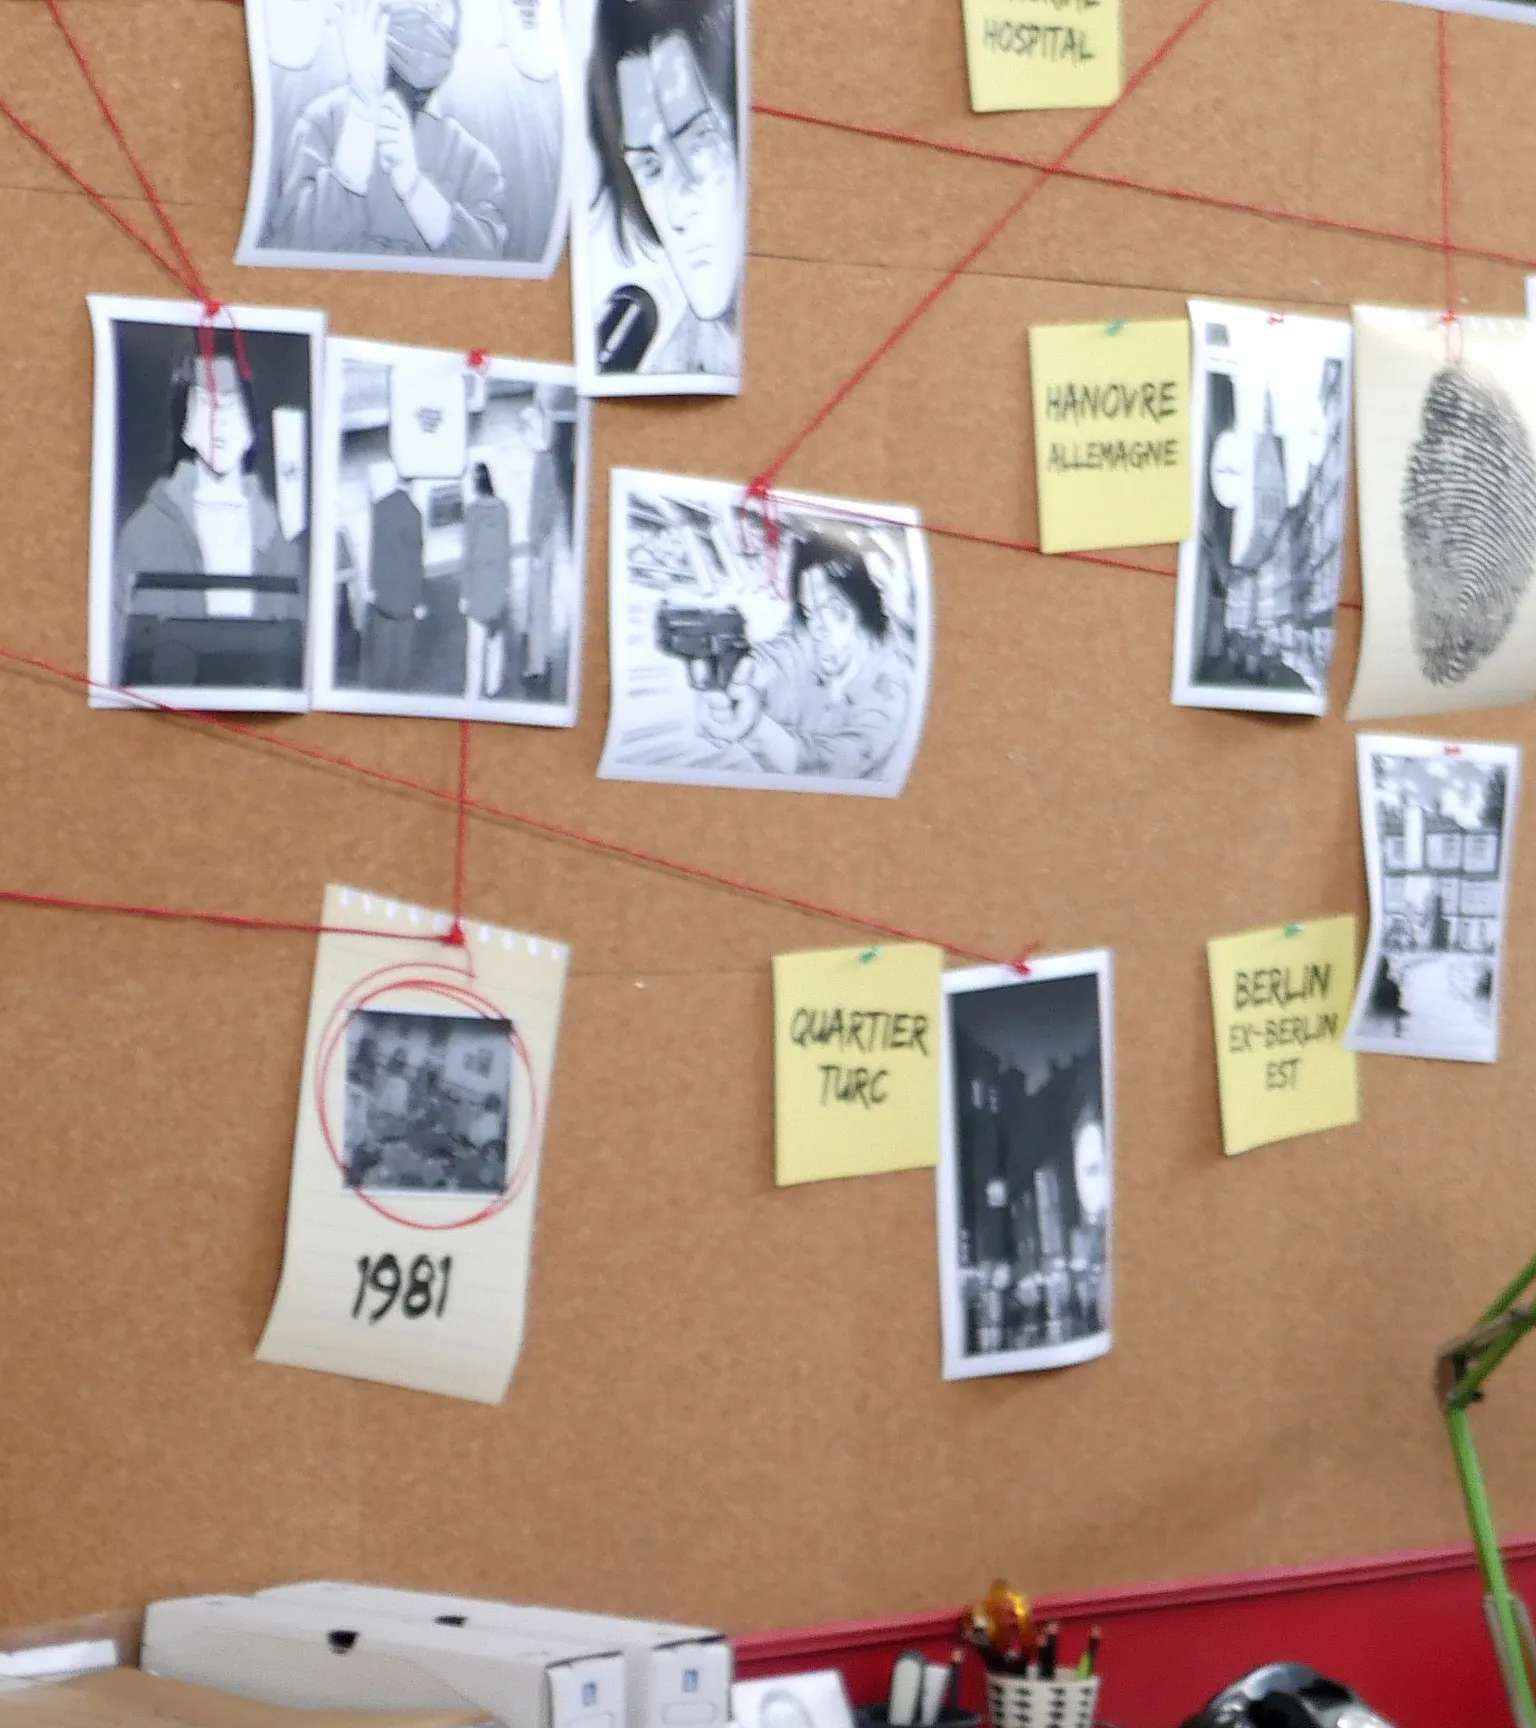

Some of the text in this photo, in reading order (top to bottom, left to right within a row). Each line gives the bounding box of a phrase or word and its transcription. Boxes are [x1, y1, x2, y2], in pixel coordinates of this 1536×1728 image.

[983, 19, 1096, 67] HOSPITAL
[1046, 380, 1178, 427] HANOVRE
[1047, 437, 1178, 476] ALLEMAGNE
[1234, 963, 1333, 1013] BERLIN
[790, 1008, 930, 1057] QUARTIER
[1228, 1011, 1340, 1054] EX-BERLIN
[819, 1062, 890, 1110] TURC
[1266, 1056, 1303, 1091] EST
[350, 1251, 453, 1327] 1981
